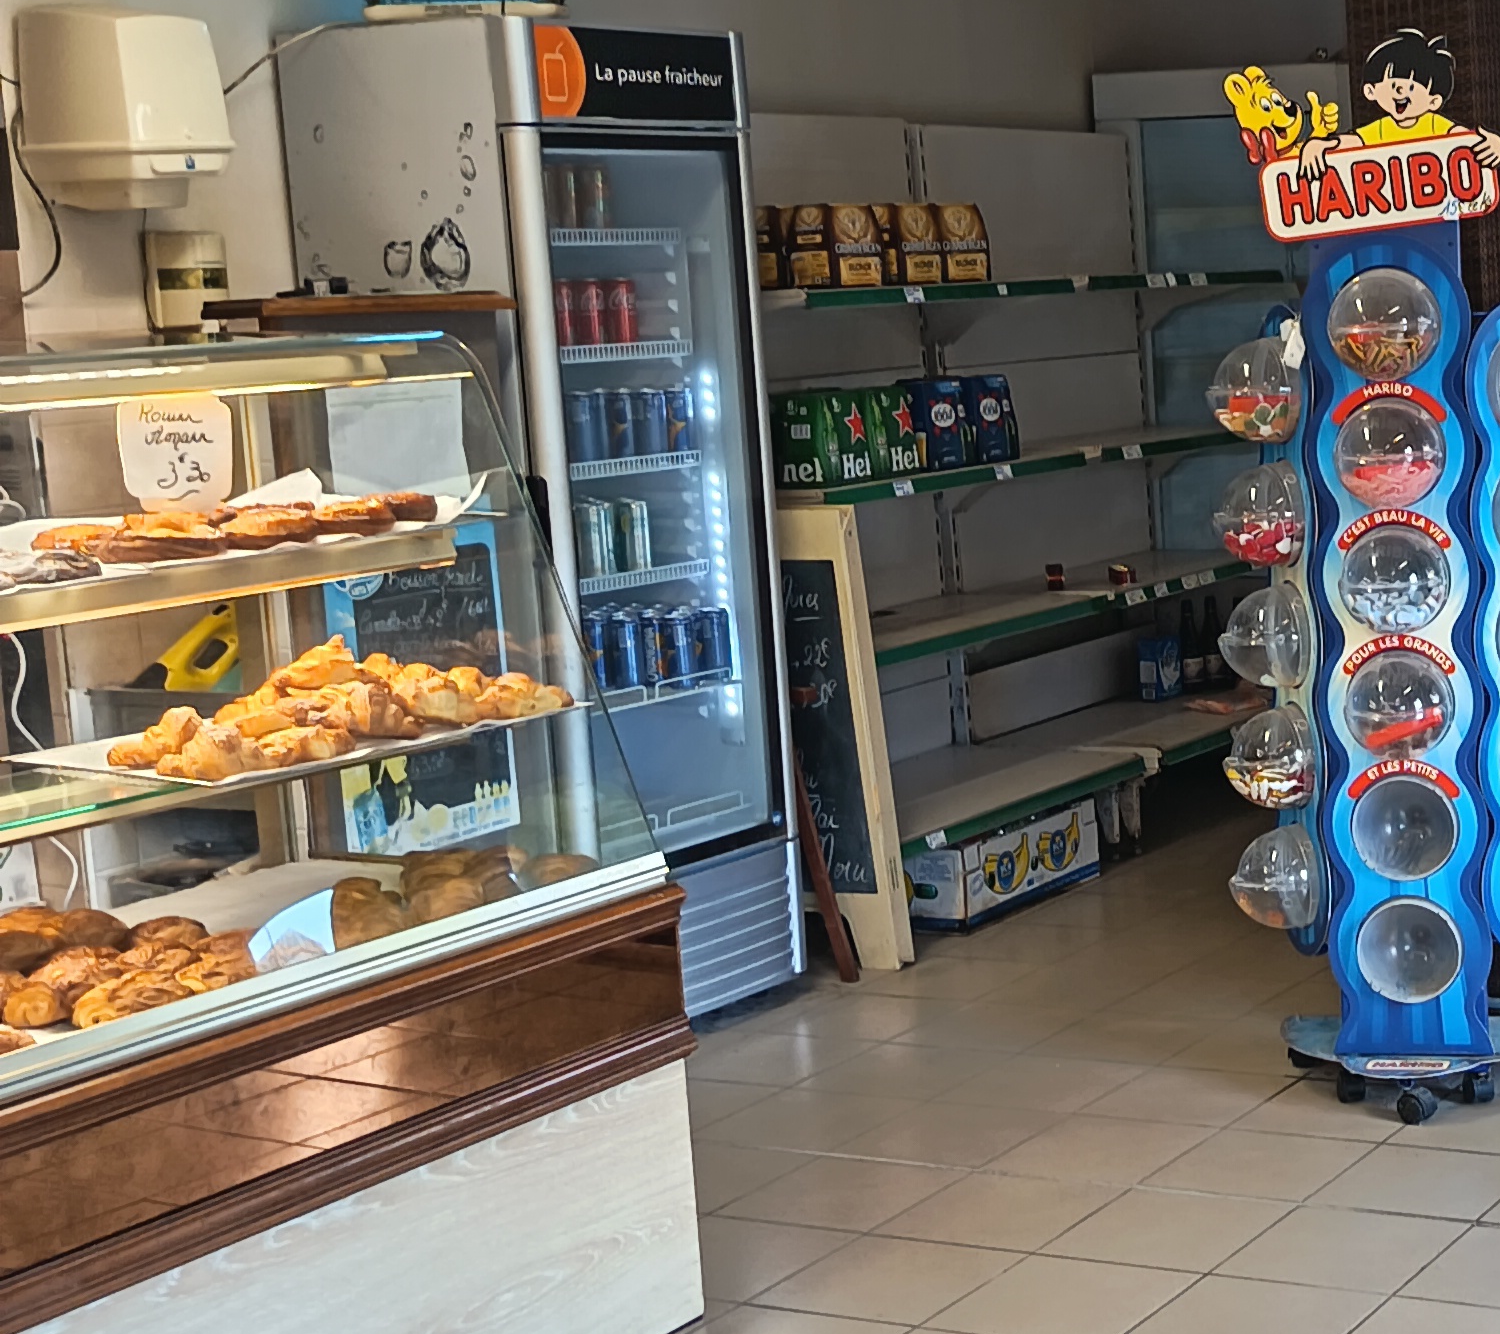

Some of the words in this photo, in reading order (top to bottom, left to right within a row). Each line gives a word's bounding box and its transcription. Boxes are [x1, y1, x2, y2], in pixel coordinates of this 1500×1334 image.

[595, 62, 614, 82] La
[617, 68, 662, 87] pause
[1277, 146, 1484, 228] HARIBO
[1363, 382, 1413, 399] HARIBO
[842, 450, 872, 480] Hei
[890, 443, 920, 472] Hei
[1343, 516, 1371, 543] C'EST
[1373, 510, 1408, 524] BEAU
[1411, 513, 1426, 529] LA
[1428, 523, 1447, 543] VIE
[1345, 642, 1377, 672] POUR
[1378, 635, 1400, 648] LES
[1403, 636, 1453, 671] GRANDS
[1366, 766, 1380, 780] ET
[1381, 760, 1400, 774] LES
[1403, 759, 1440, 781] PETITS
